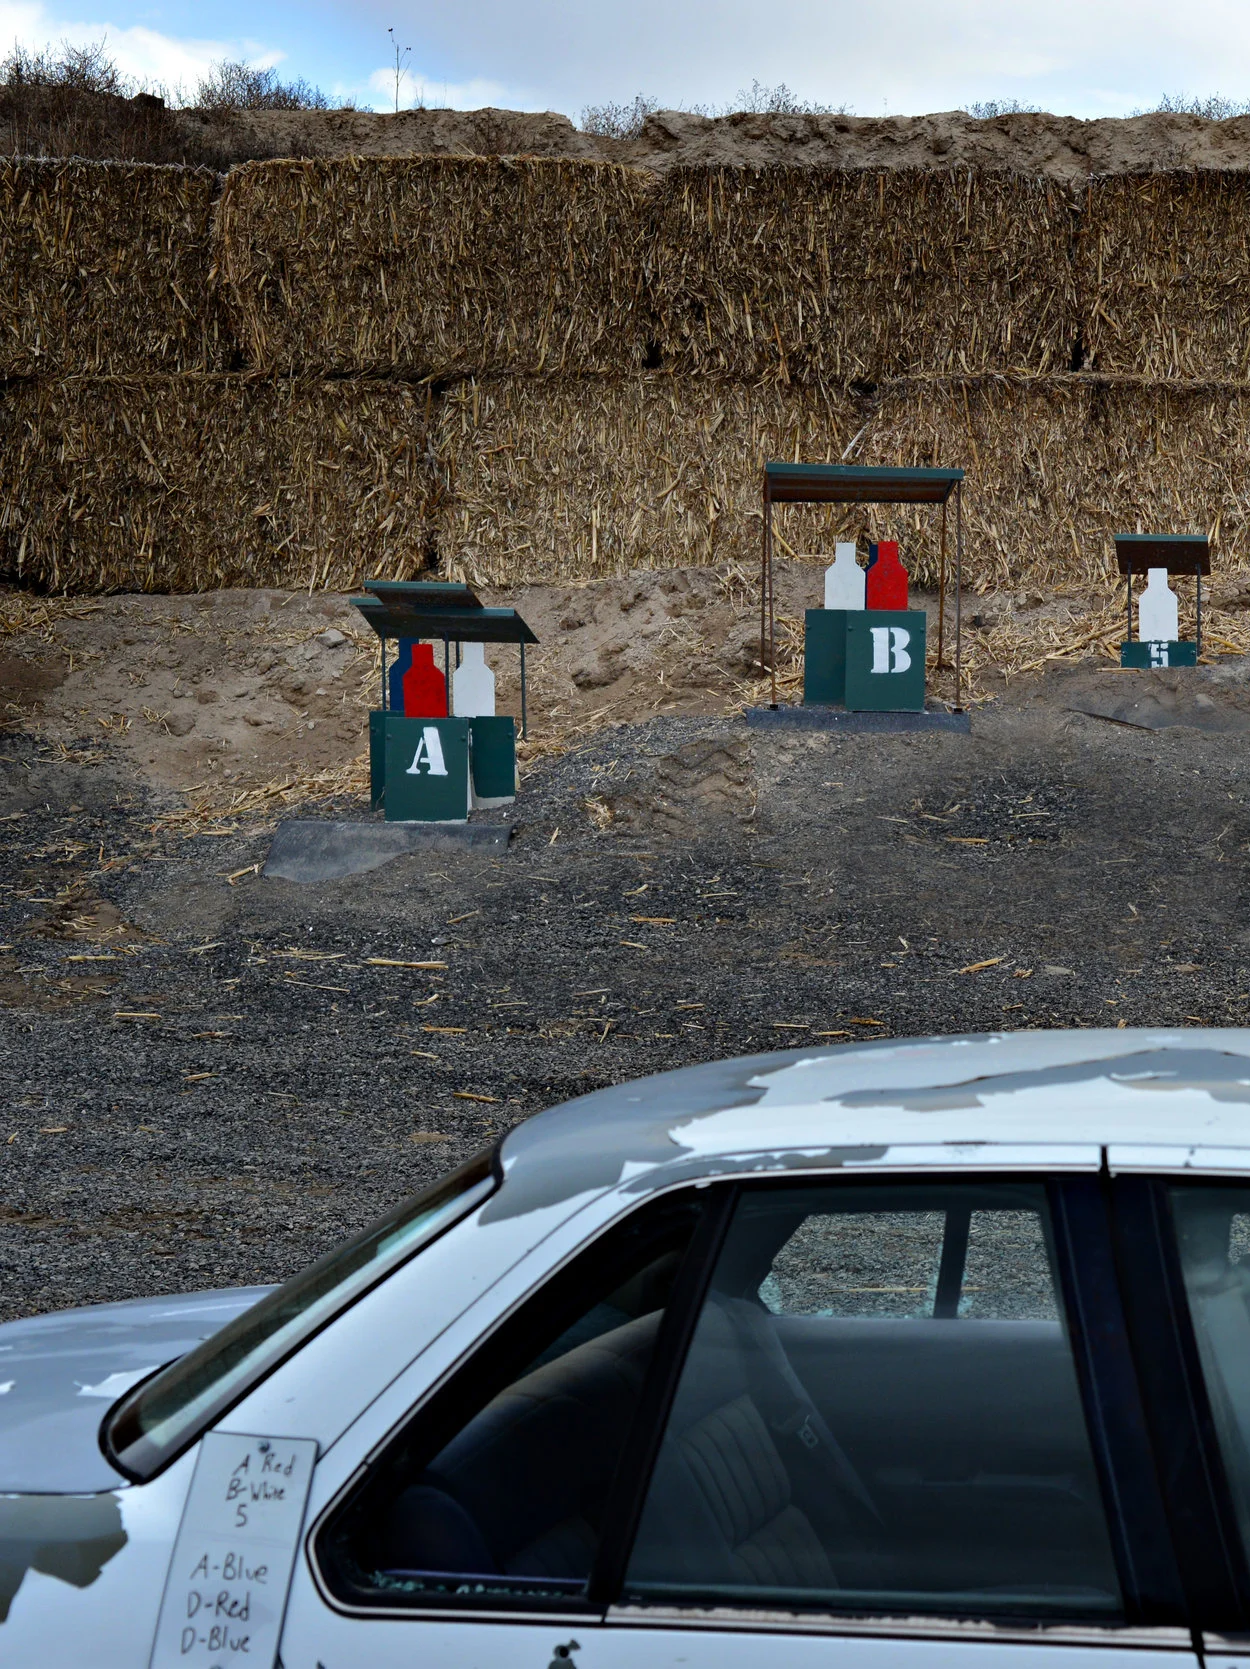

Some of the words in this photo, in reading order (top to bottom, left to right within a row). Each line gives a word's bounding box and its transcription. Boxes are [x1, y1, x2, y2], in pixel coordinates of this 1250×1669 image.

[869, 627, 911, 674] B
[405, 726, 449, 776] A
[231, 1453, 251, 1476] A
[260, 1452, 296, 1477] Red
[189, 1551, 269, 1585] A-Blue
[186, 1590, 251, 1622] D-Red
[180, 1625, 251, 1655] D-Blue
